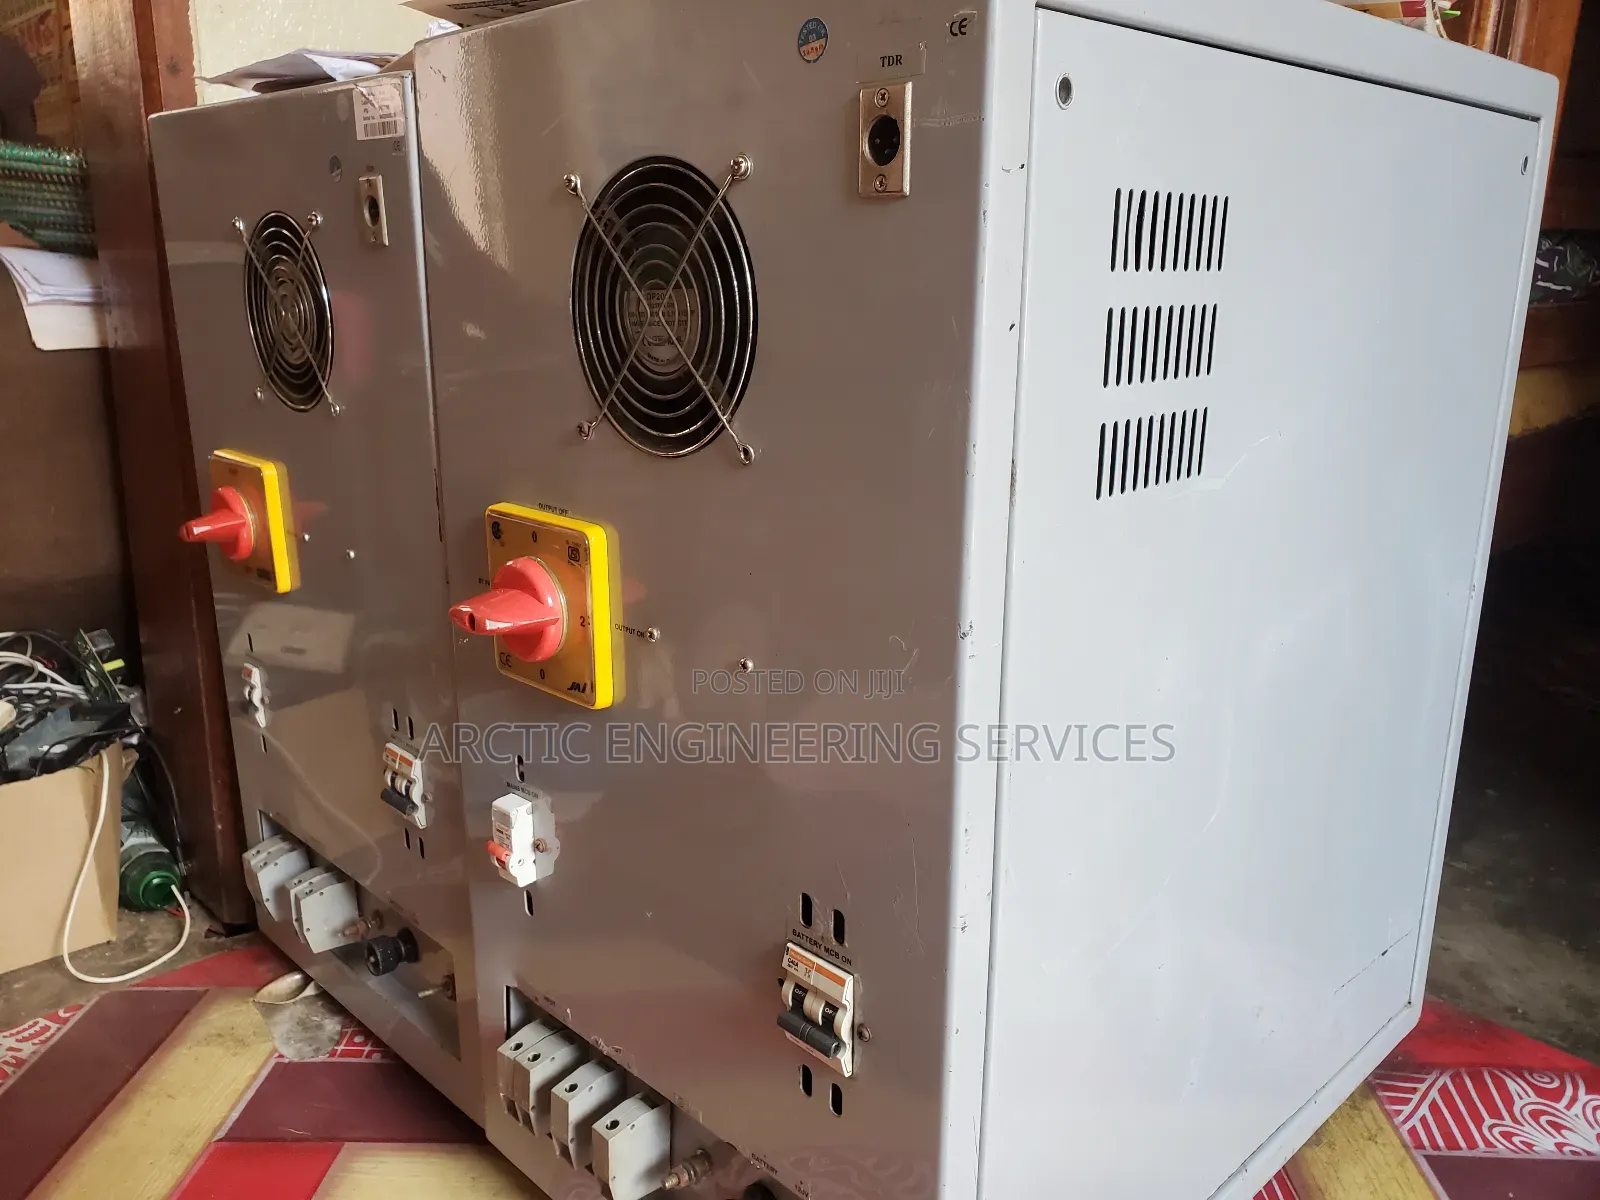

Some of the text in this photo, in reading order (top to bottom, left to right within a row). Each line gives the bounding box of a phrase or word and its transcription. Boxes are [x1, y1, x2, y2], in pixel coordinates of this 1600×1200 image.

[880, 54, 903, 68] TDR
[580, 616, 586, 627] 2
[615, 623, 636, 635] OUTPUT
[793, 929, 822, 949] BATTERY
[824, 946, 840, 959] MCB
[841, 955, 852, 966] ON
[751, 1153, 778, 1175] BATTERY
